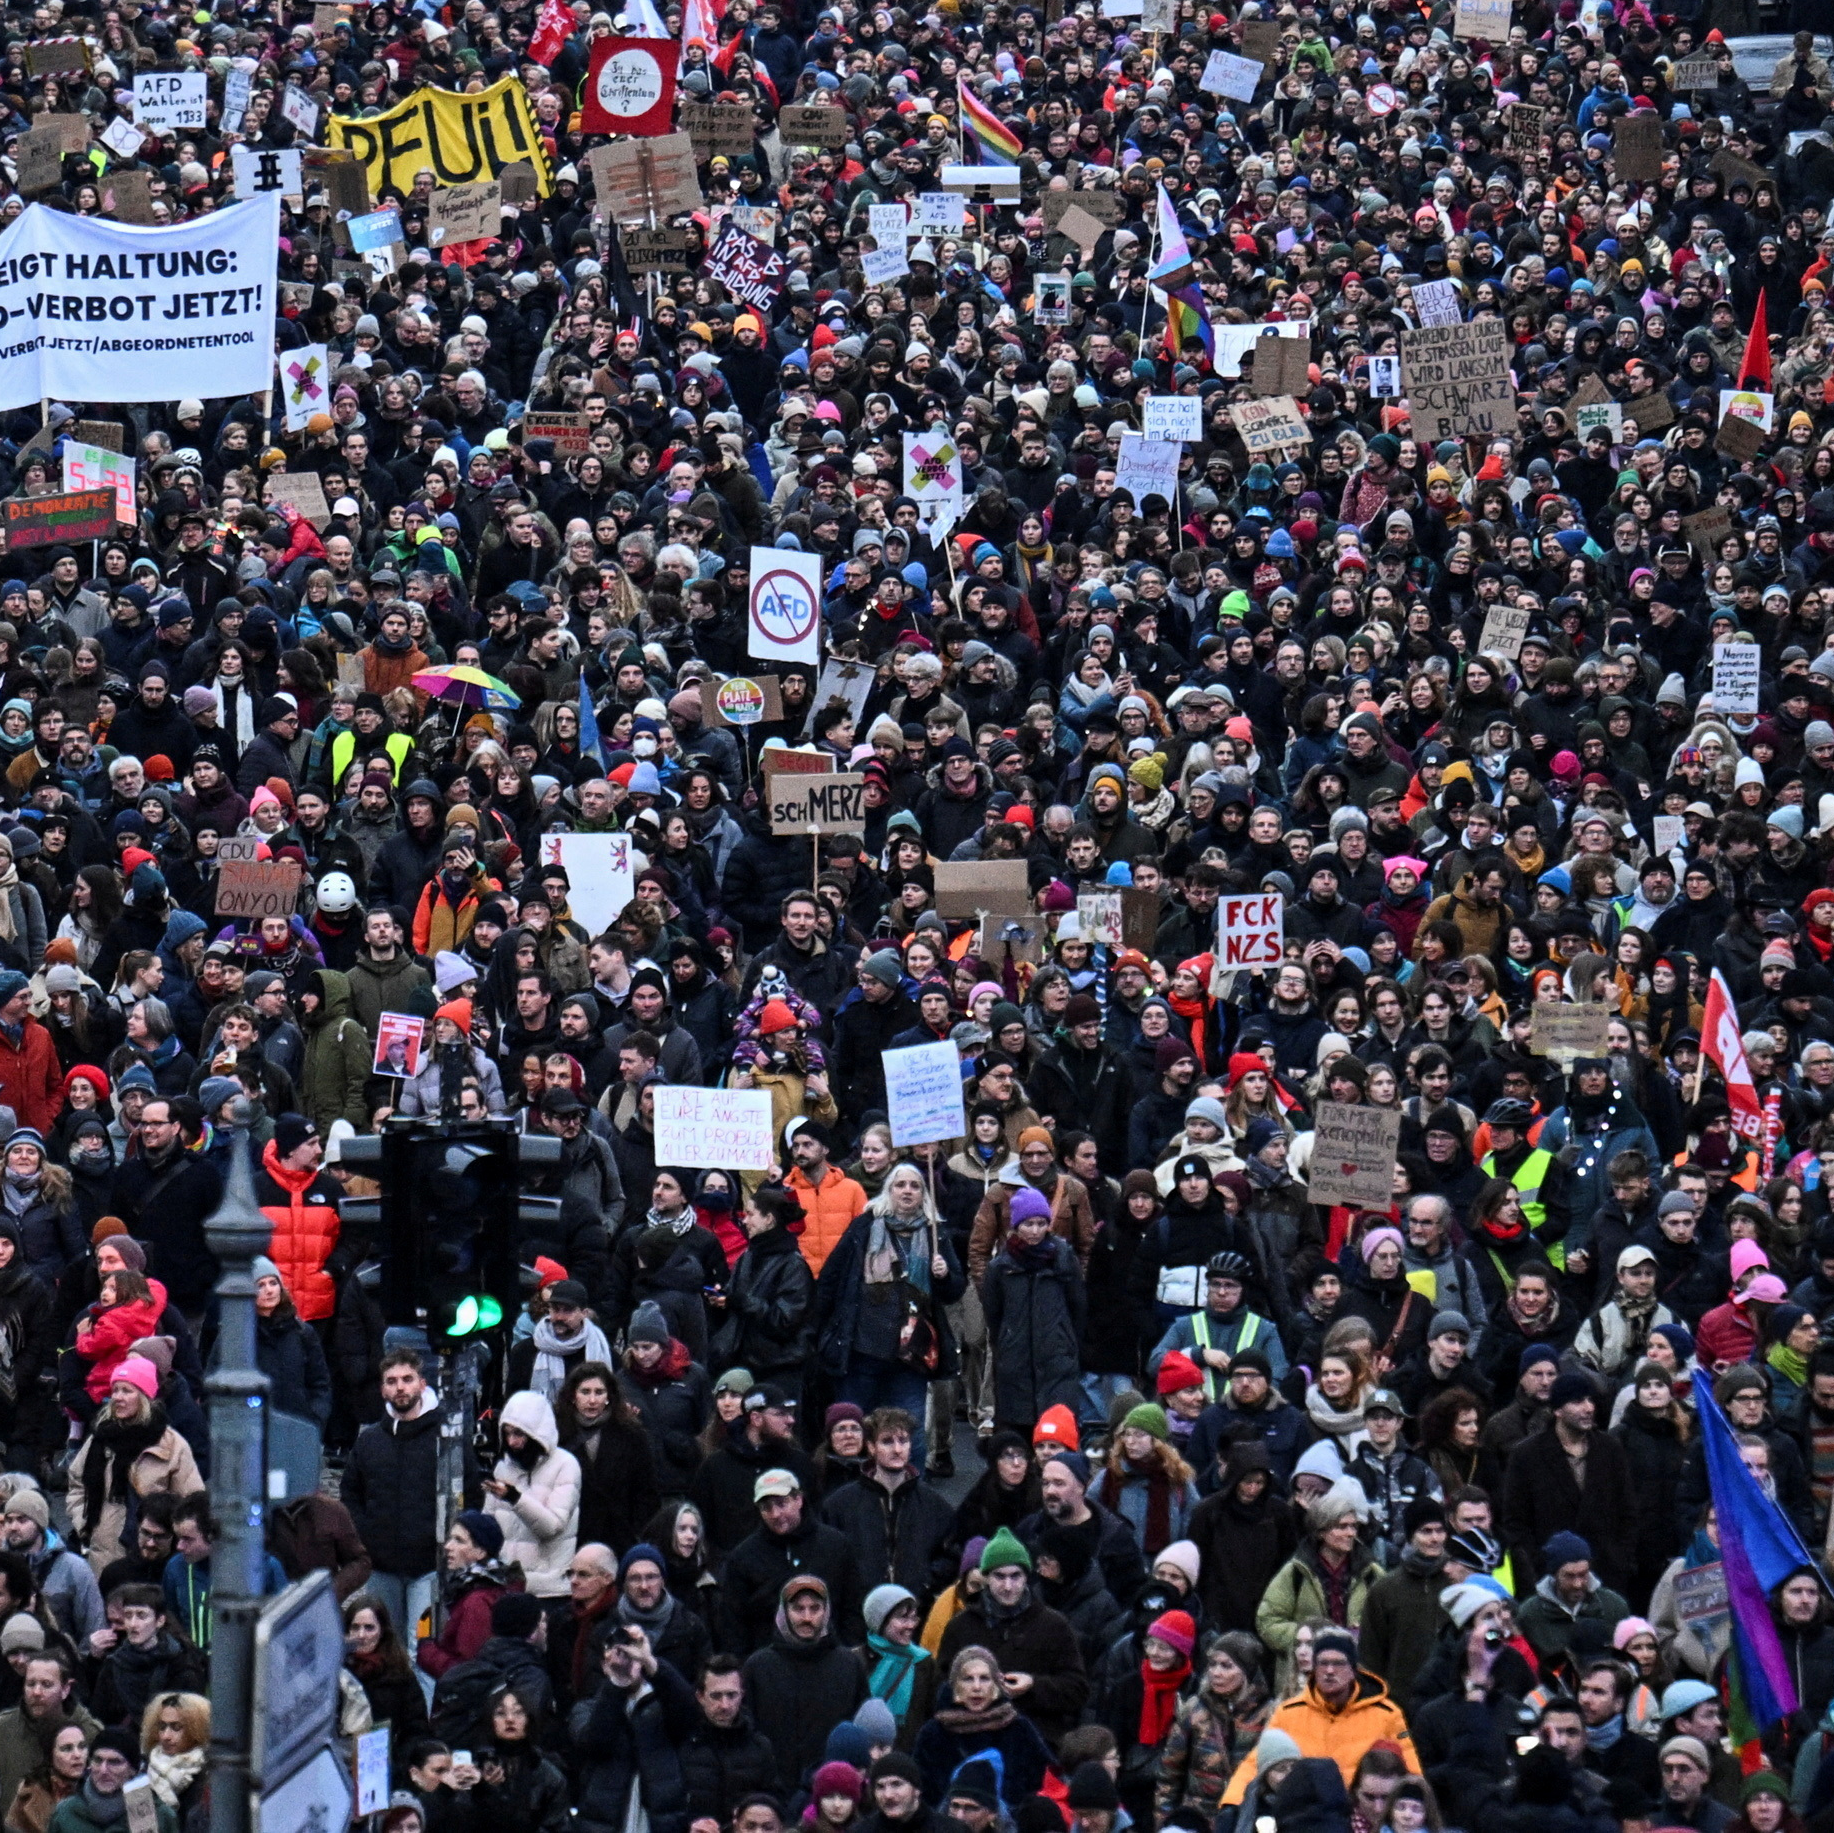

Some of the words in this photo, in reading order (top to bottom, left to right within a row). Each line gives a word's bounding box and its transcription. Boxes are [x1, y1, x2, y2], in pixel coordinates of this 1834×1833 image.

[142, 77, 183, 94] AFD
[726, 227, 757, 257] DAS
[66, 247, 238, 280] HALTUNG:
[162, 284, 263, 319] JETZT!
[1412, 283, 1445, 299] KEIN
[1417, 295, 1456, 311] MERZ
[1452, 325, 1469, 341] ICH
[1473, 319, 1503, 337] DURCH
[1478, 338, 1504, 356] LAUF
[1409, 364, 1443, 381] WIRD
[1448, 356, 1506, 380] LANGSAM
[1413, 379, 1508, 411] SCHWARZ
[1437, 412, 1493, 438] BLAU
[759, 593, 808, 621] AFD
[724, 688, 750, 703] PLATZ
[218, 840, 255, 861] CDU
[245, 889, 296, 916] YOU
[1225, 897, 1278, 928] FCK
[1225, 931, 1281, 965] NZS
[660, 1104, 705, 1122] EURE
[661, 1126, 697, 1142] ZUM
[704, 1128, 773, 1145] PROBLEM
[662, 1145, 701, 1161] ALLER
